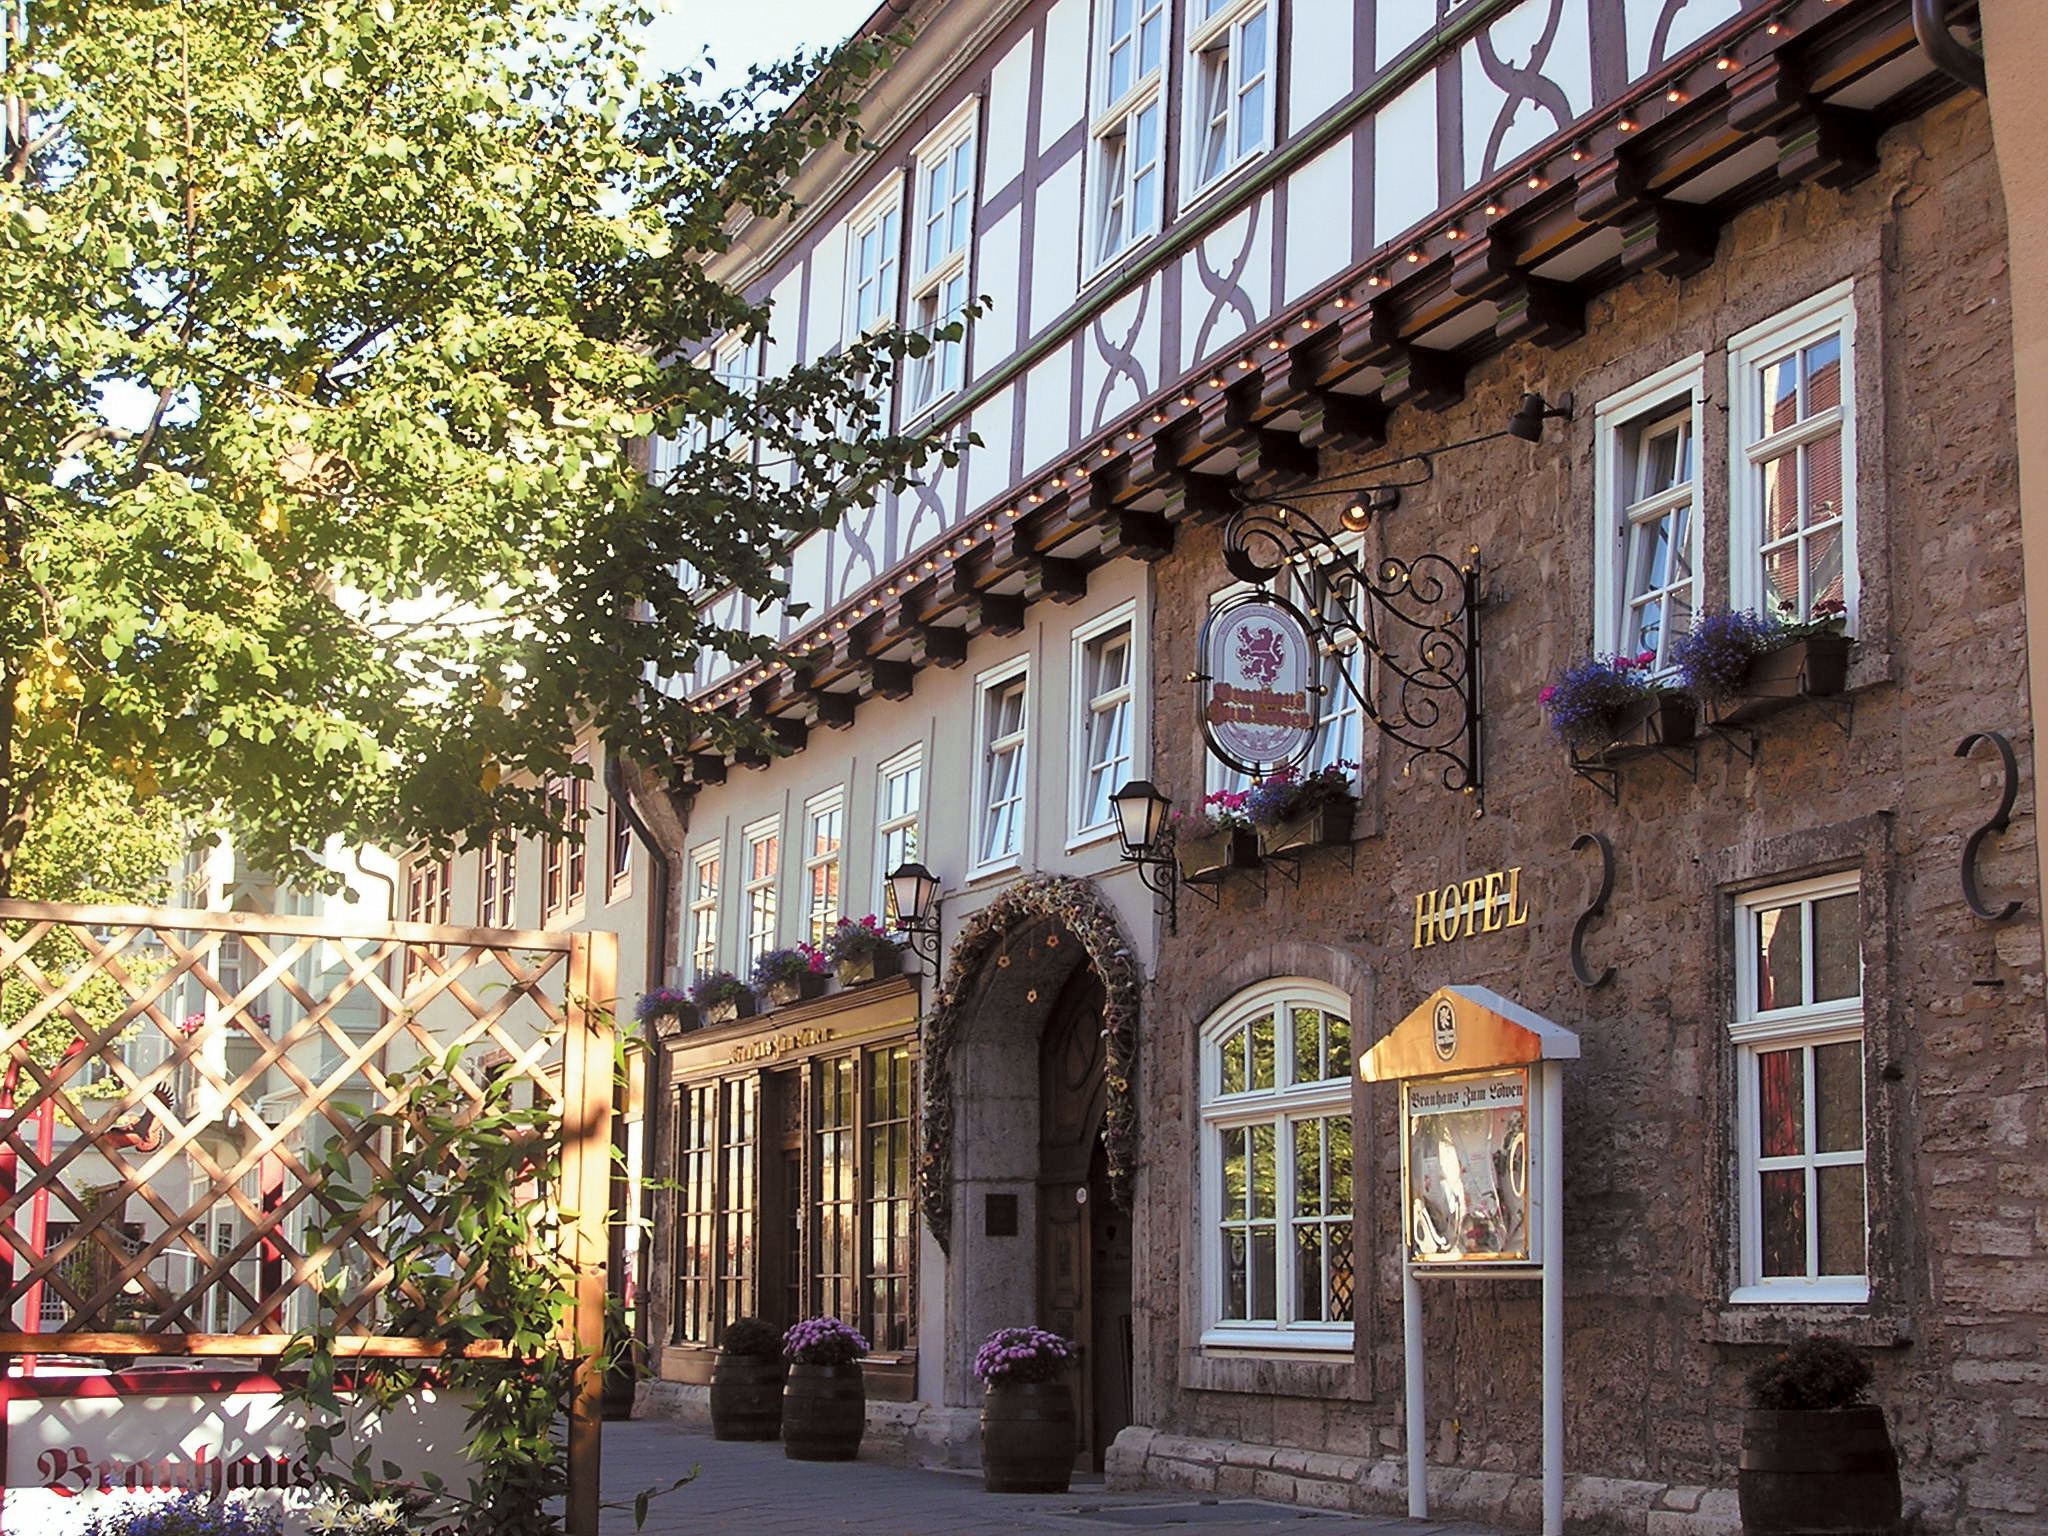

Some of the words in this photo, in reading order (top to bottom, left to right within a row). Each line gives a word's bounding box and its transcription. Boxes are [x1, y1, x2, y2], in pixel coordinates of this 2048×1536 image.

[1411, 866, 1529, 951] HOTEL
[1410, 1090, 1459, 1108] Brauhaus
[1462, 1086, 1486, 1107] Zum
[1489, 1082, 1523, 1100] Löwen
[37, 1442, 320, 1505] Brauhaus
